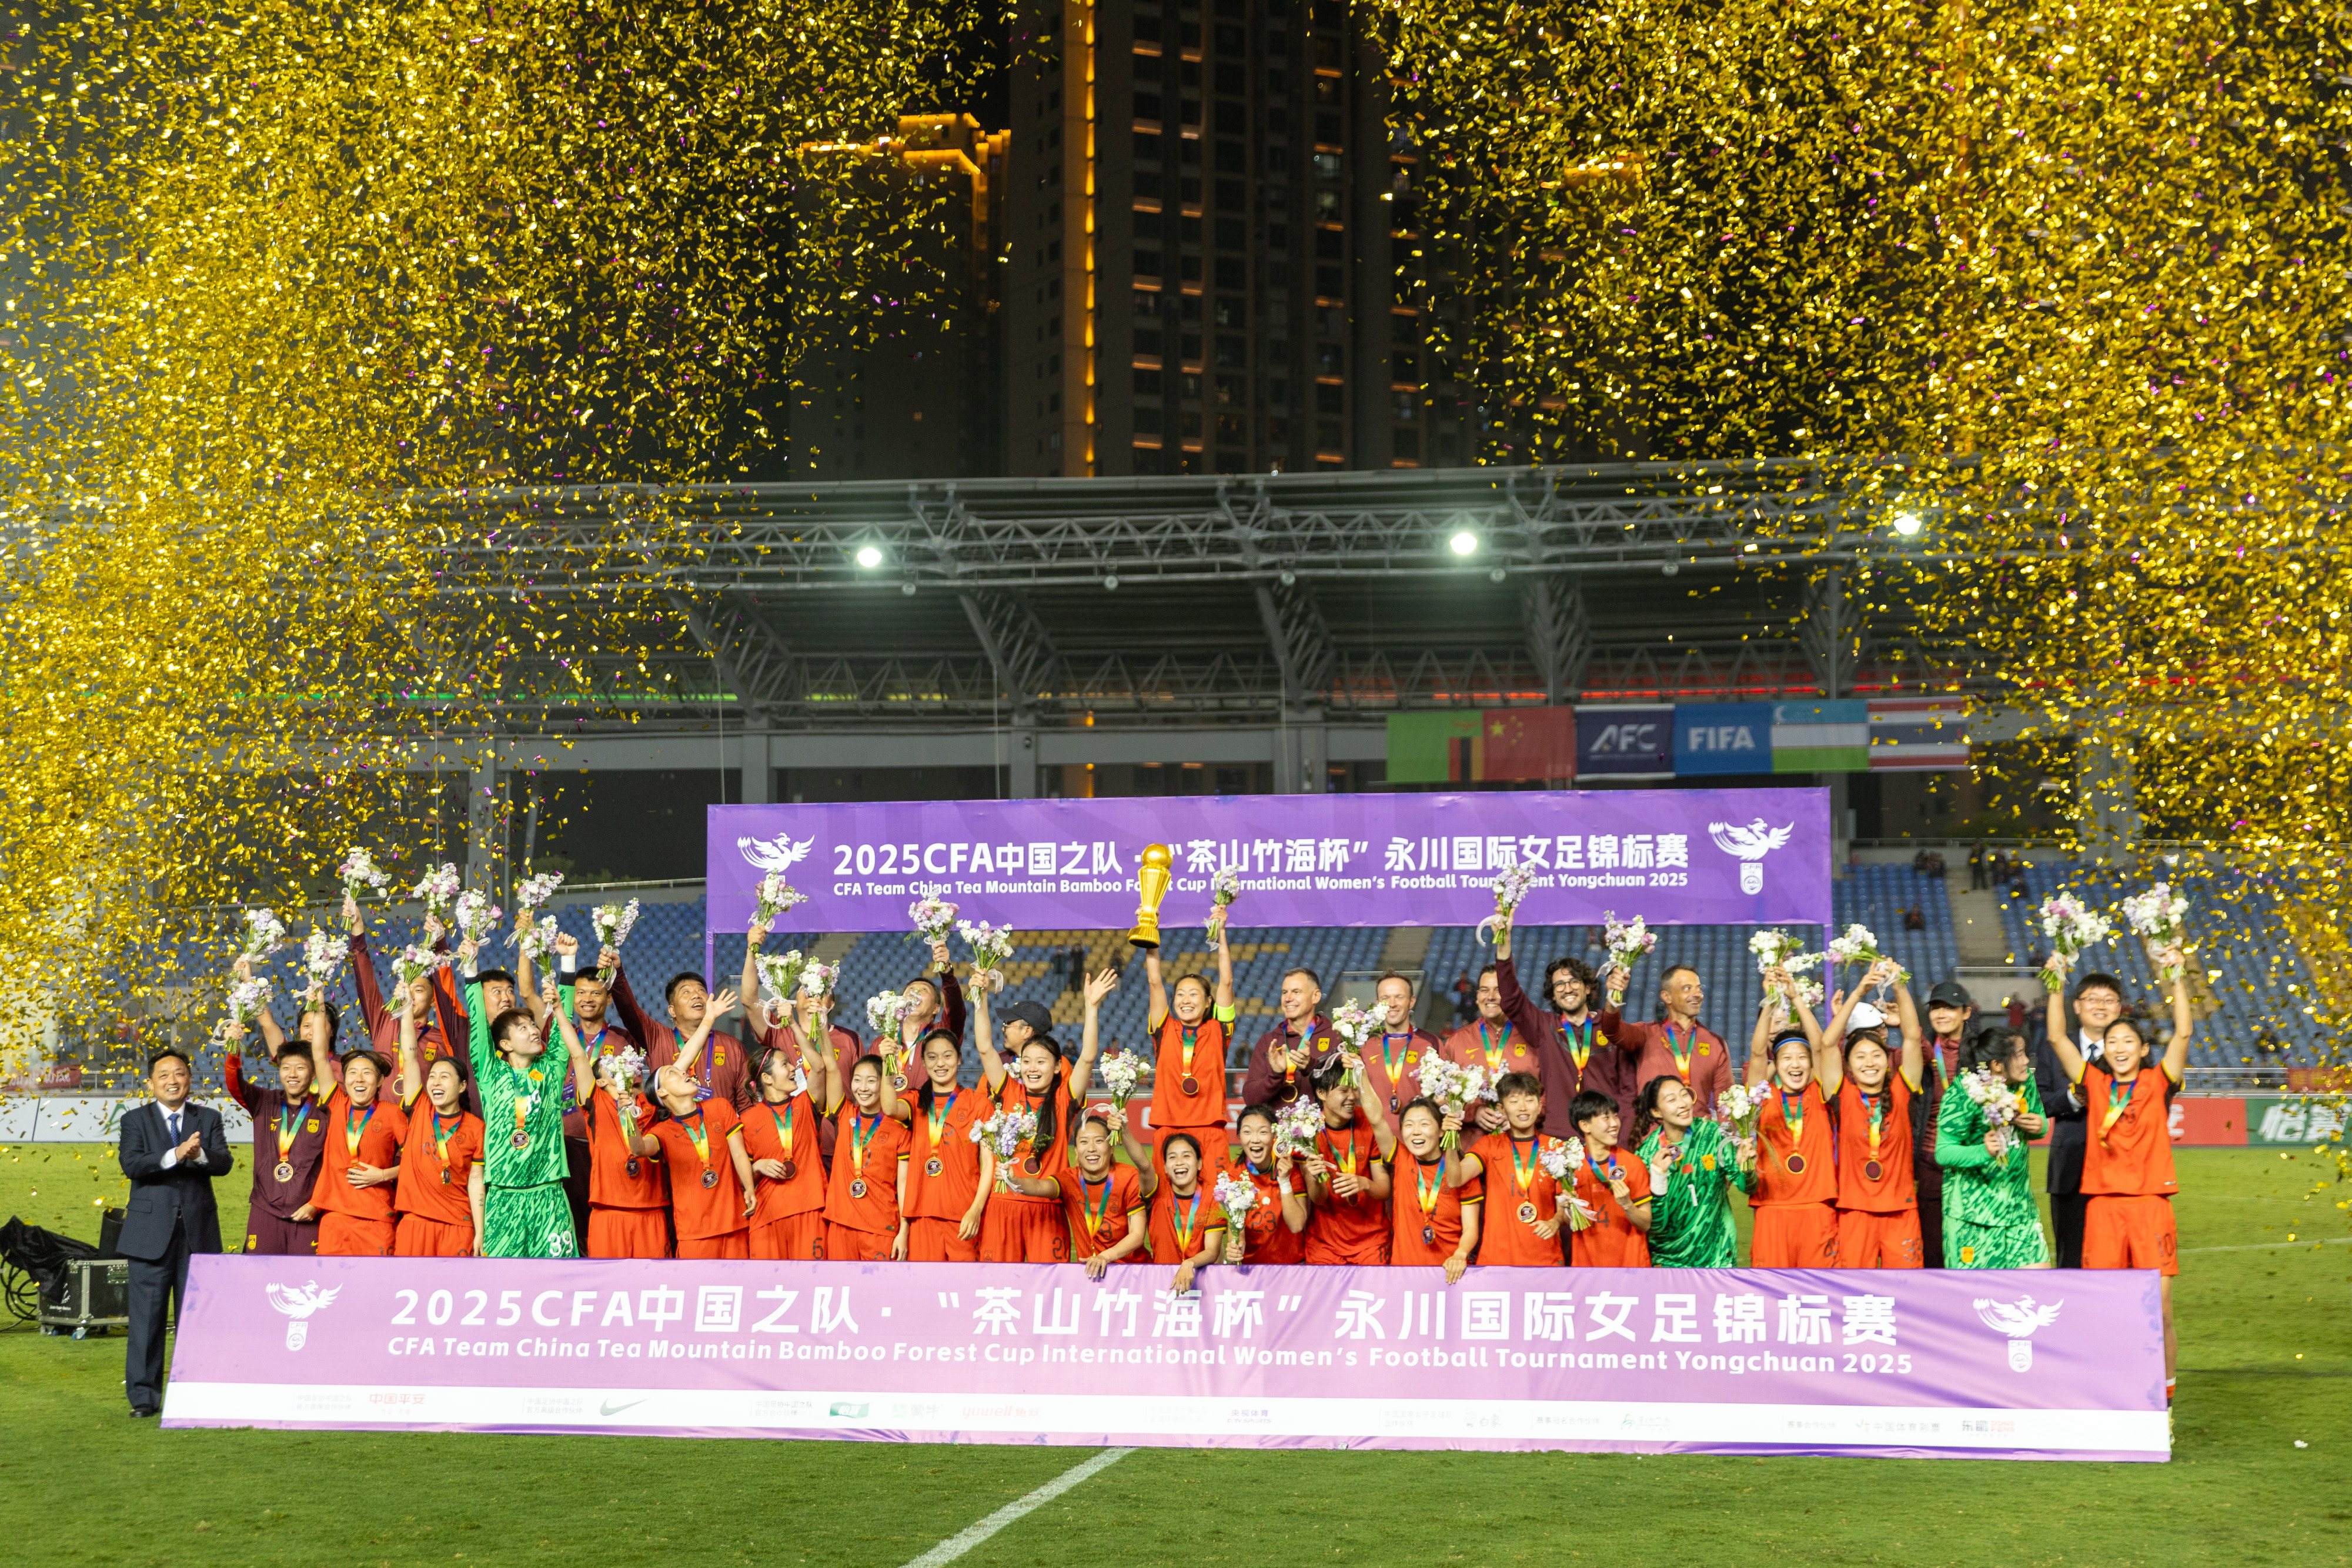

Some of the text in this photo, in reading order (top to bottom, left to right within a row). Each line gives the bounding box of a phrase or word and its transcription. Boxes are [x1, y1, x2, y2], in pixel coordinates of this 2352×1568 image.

[1589, 724, 1657, 753] AFC
[1688, 725, 1756, 752] FIFA
[834, 882, 862, 896] CFA
[866, 882, 905, 895] Team
[909, 880, 951, 894] China
[955, 881, 981, 894] Tea
[986, 879, 1056, 893] Mountain
[1060, 878, 1122, 892] Bamboo
[1177, 878, 1207, 893] Cup
[1211, 876, 1311, 891] Irnational
[1315, 875, 1385, 890] Women's
[1391, 874, 1456, 889] Football
[1460, 874, 1555, 888] Tourent
[1558, 872, 1645, 889] Yongchuan
[1649, 872, 1688, 887] 2025
[1687, 1183, 1698, 1207] 1
[1251, 1211, 1277, 1233] 23
[547, 1230, 573, 1256] 39
[813, 1237, 824, 1260] 6
[1335, 1289, 1897, 1346] 永川国际女足锦标赛
[389, 1338, 1912, 1373] CFA Team China Tea Mountain Bamboo Forest Cup International Women's Football Tournament Yongchuan 2025
[369, 1393, 426, 1405] 中国平安
[961, 1405, 1013, 1419] yuwell
